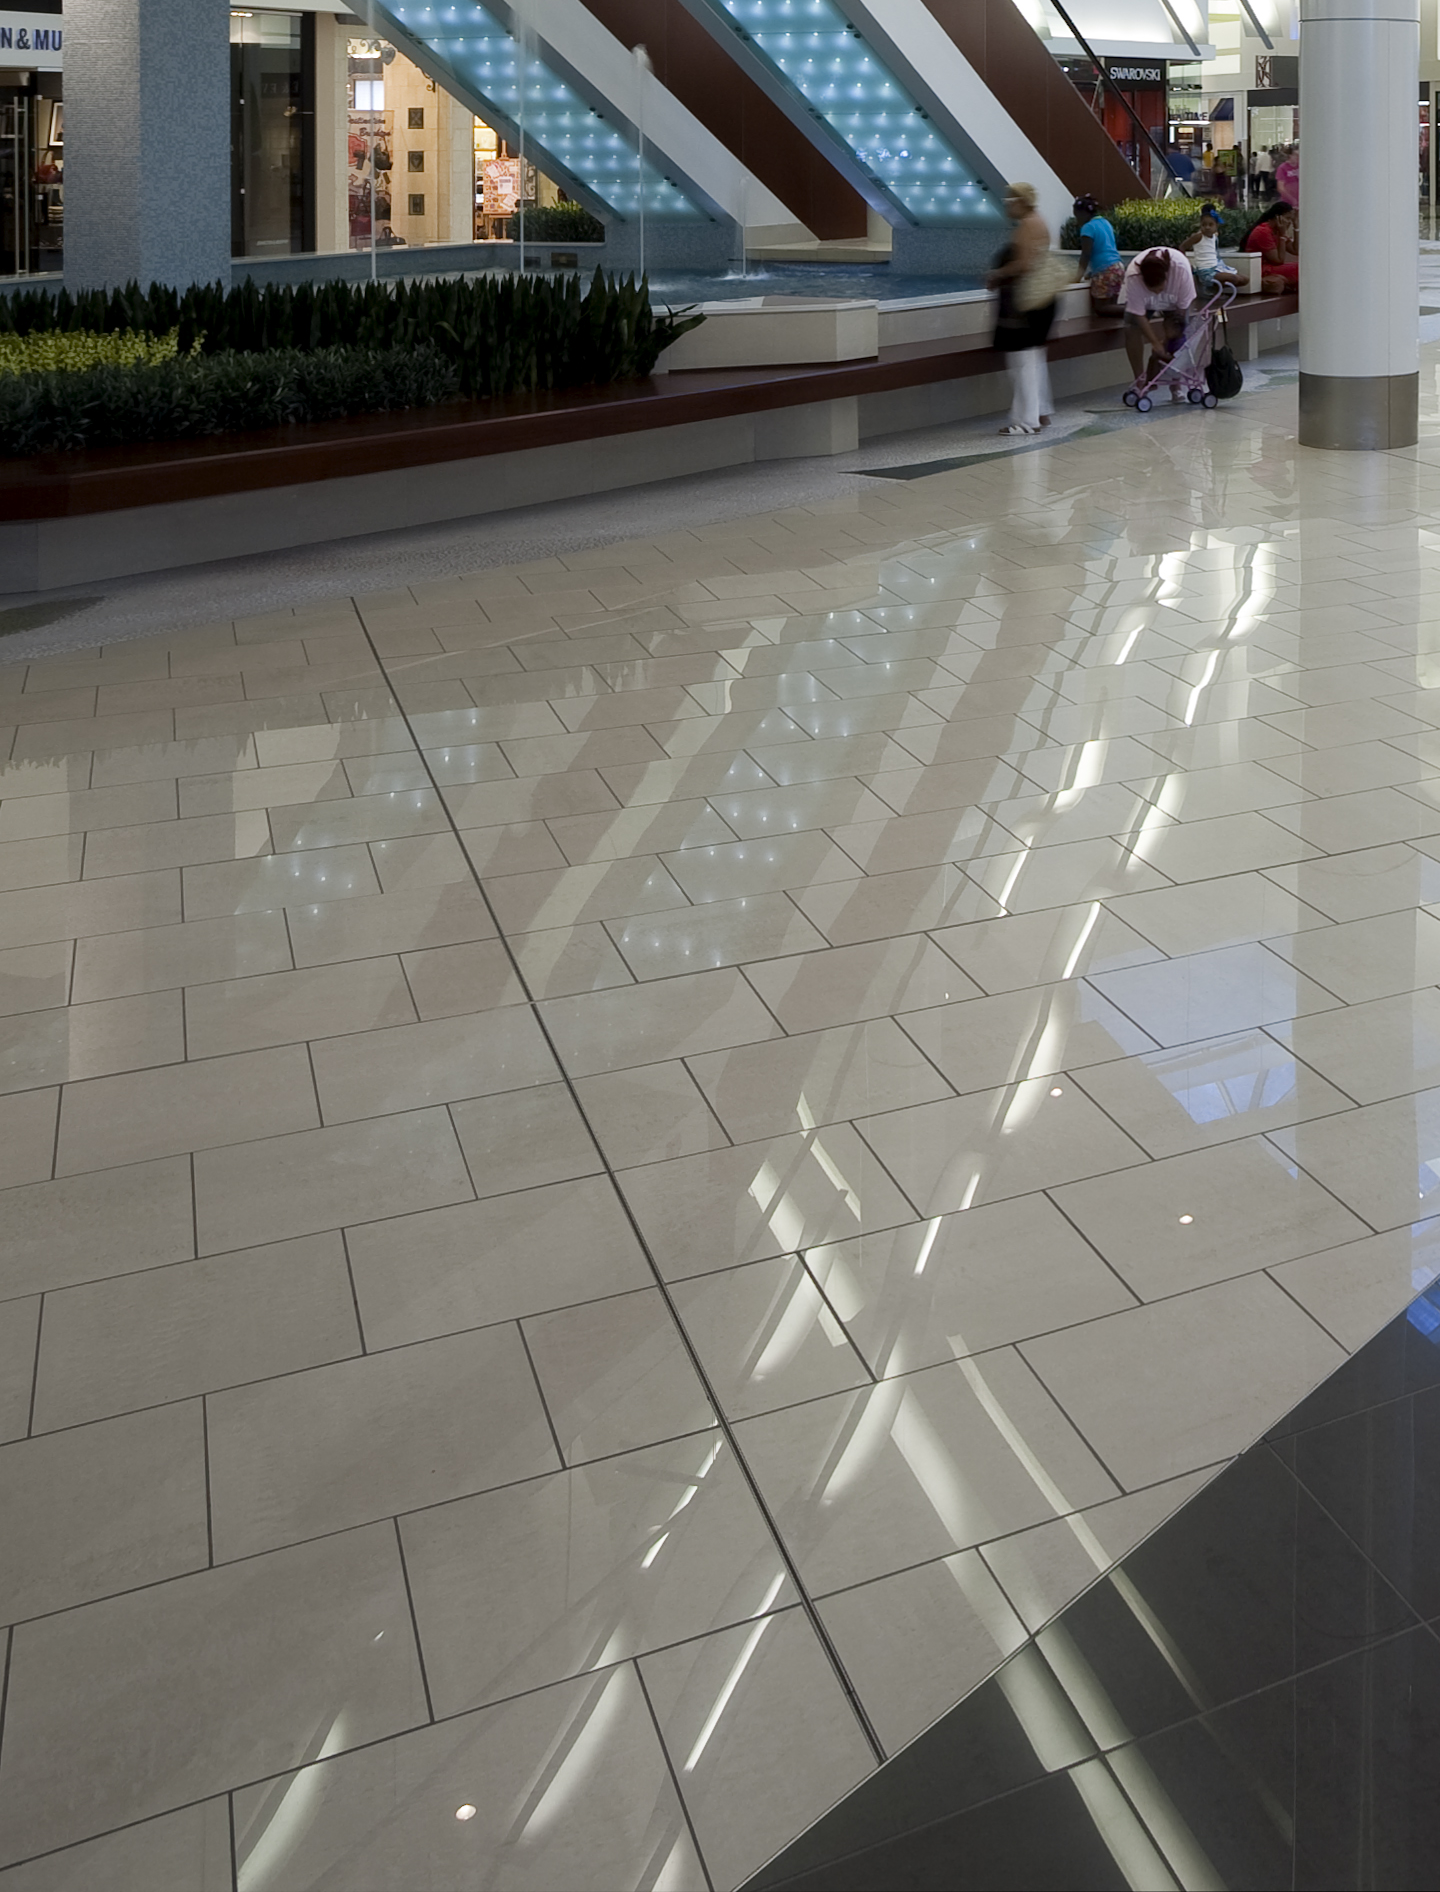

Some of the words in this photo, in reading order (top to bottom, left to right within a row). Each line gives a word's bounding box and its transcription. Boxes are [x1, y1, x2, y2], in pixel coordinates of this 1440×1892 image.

[16, 27, 31, 50] &
[33, 28, 63, 52] MU
[1110, 67, 1161, 81] SWAROVSKI
